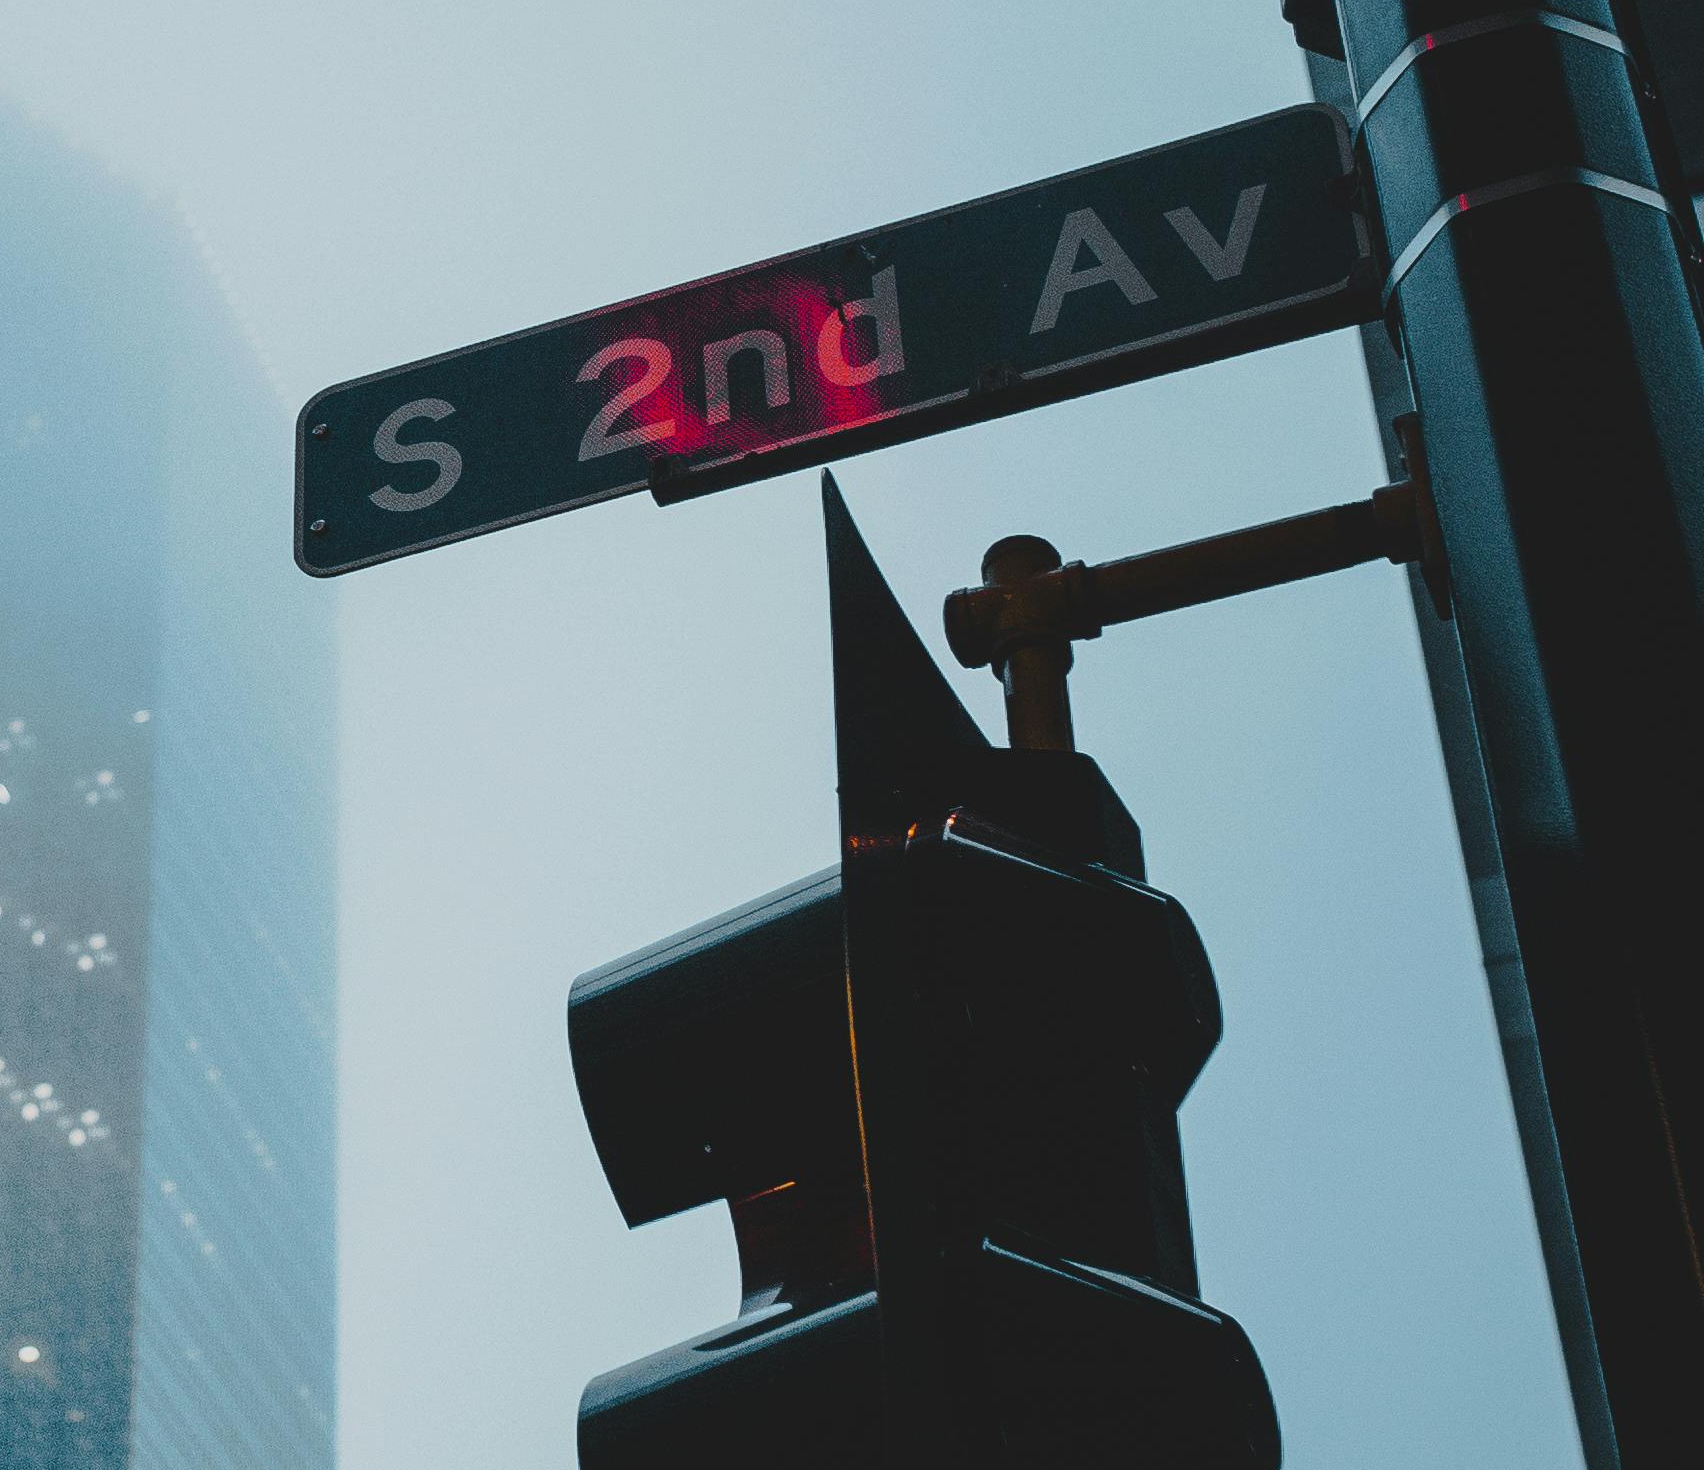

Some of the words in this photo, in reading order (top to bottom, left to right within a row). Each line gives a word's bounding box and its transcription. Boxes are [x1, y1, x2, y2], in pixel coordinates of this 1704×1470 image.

[367, 397, 464, 513] S
[574, 264, 908, 463] 2nd
[1027, 182, 1268, 336] Av
